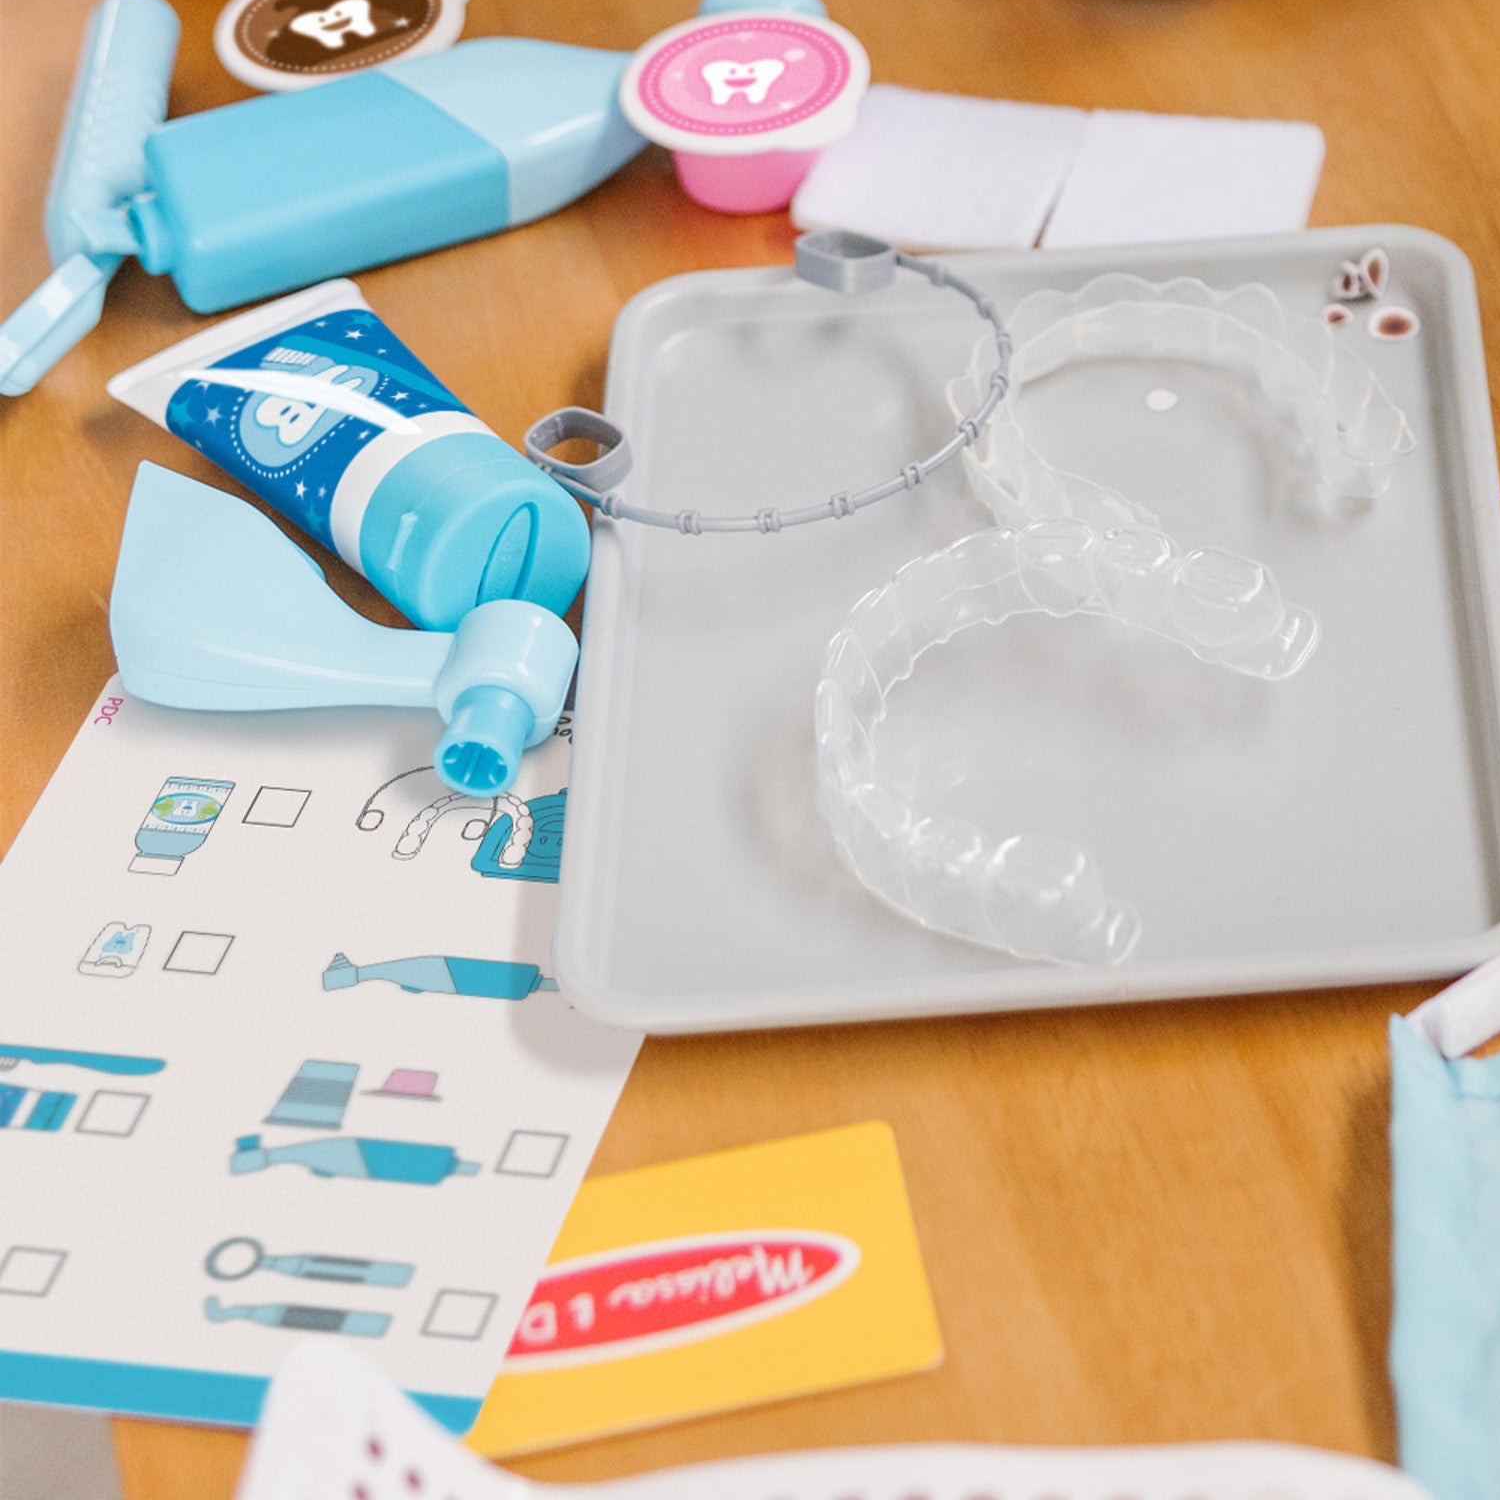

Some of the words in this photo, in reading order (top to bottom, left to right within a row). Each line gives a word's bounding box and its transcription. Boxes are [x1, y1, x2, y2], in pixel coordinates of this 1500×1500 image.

[94, 697, 124, 725] PDC
[606, 1243, 816, 1311] Melissa
[569, 1292, 596, 1332] &
